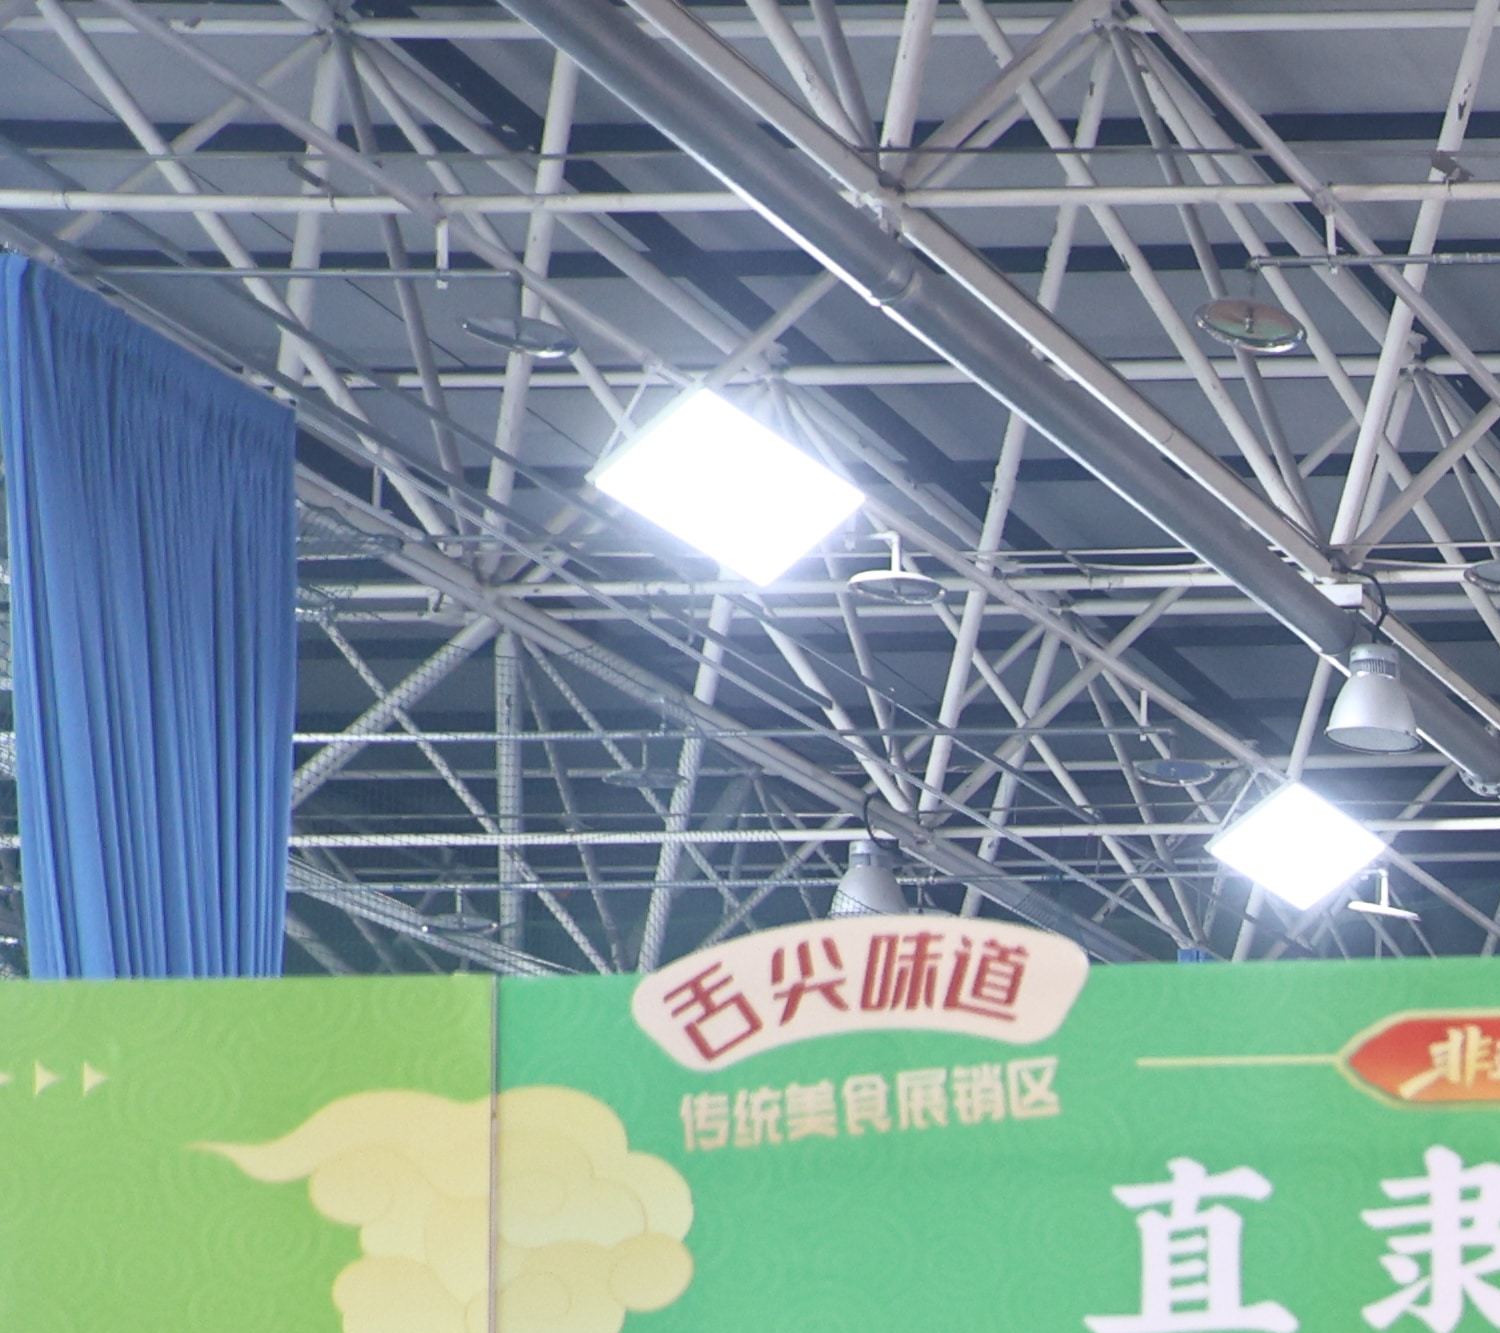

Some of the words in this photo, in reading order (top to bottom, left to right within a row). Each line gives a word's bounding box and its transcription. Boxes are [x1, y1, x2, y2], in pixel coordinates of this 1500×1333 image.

[663, 931, 1029, 1062] 舌尖味道
[679, 1056, 1061, 1150] 传统美食展销区
